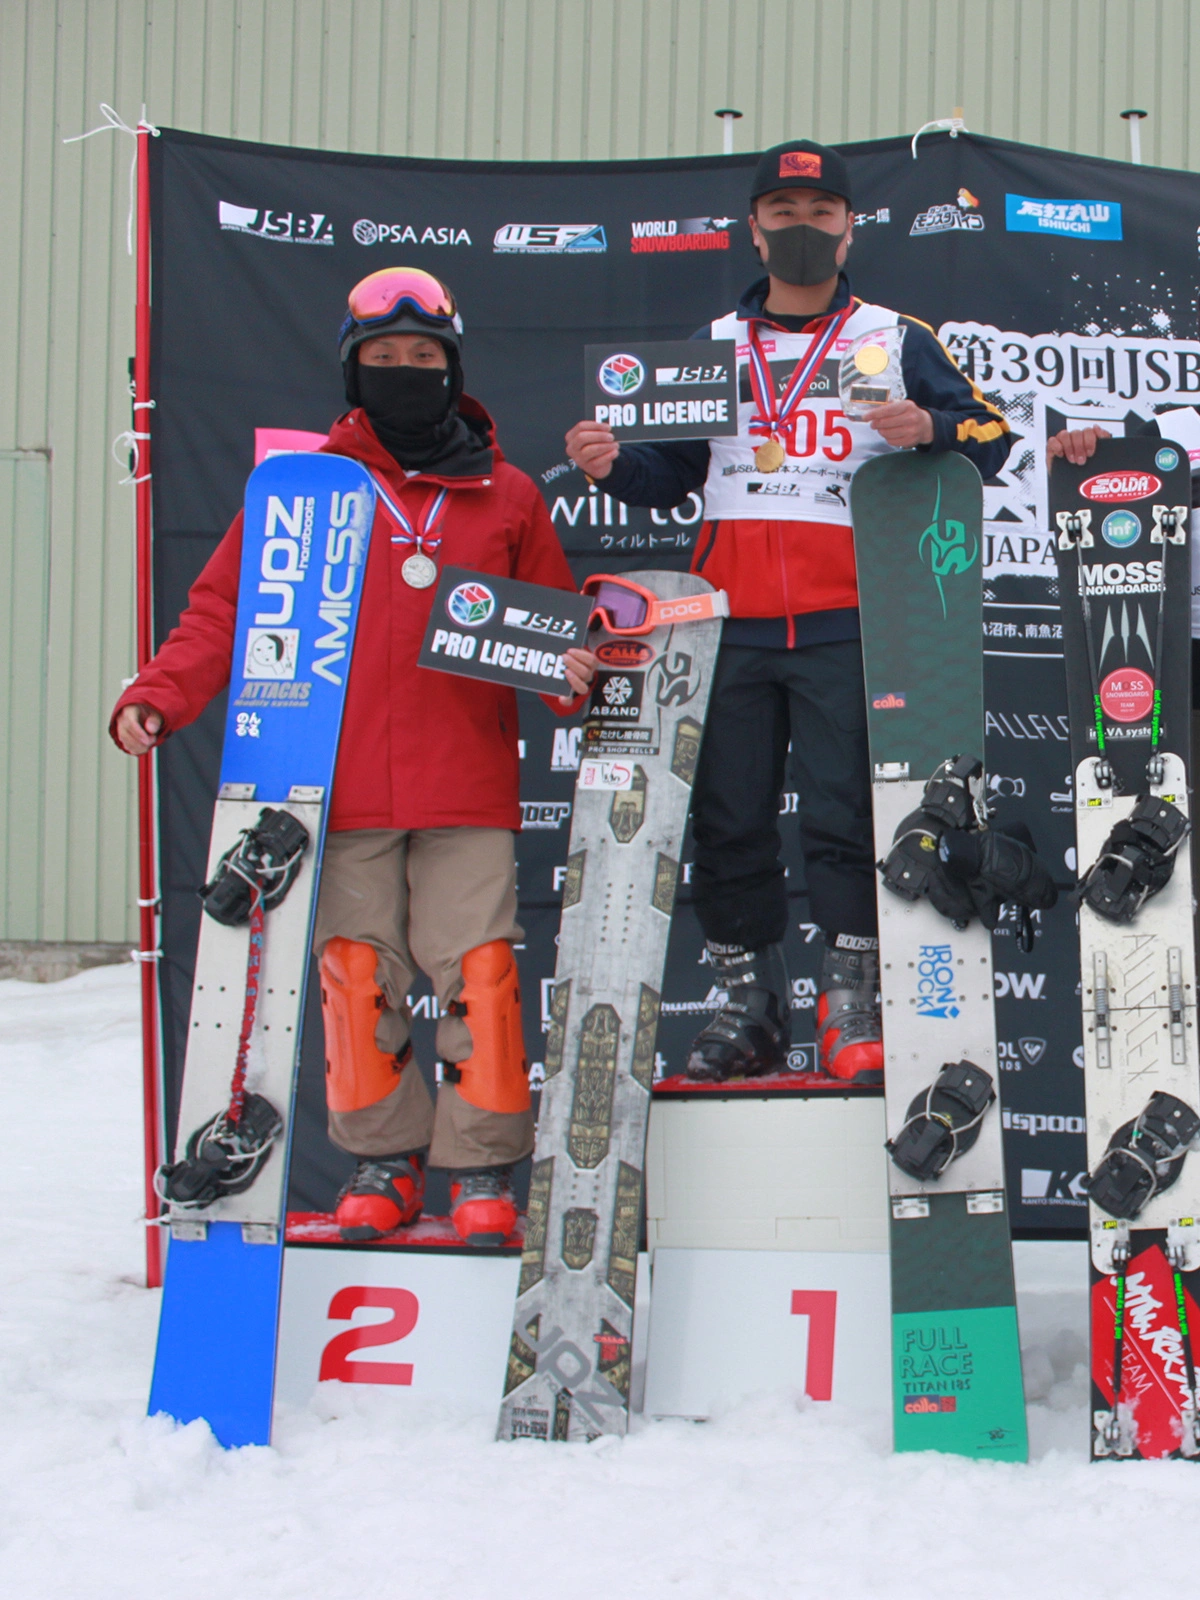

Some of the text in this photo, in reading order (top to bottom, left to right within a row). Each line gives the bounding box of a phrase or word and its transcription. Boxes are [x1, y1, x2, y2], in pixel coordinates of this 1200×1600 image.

[1016, 201, 1110, 222] 石打丸山
[246, 209, 335, 240] JSBA
[378, 224, 472, 246] PSA ASIA
[631, 221, 677, 238] WORLD
[1038, 217, 1091, 233] ISHIUCHI
[631, 231, 731, 254] SNOWBOARDING
[673, 364, 728, 383] JSBA
[595, 399, 729, 429] PRO LICENCE
[751, 408, 853, 462] 05
[757, 482, 800, 496] JSBA
[298, 496, 316, 570] hardboots
[600, 533, 691, 550] ウィルトール
[254, 495, 305, 626] UPZ
[1078, 561, 1165, 586] MOSS
[1078, 583, 1167, 596] SNOWBOARDS
[522, 611, 578, 638] JSBA
[431, 628, 477, 661] PRO
[479, 638, 567, 681] LICENCE
[239, 681, 312, 700] ATTACKS
[1111, 681, 1144, 691] MOSS
[590, 705, 640, 718] ABAND
[1089, 727, 1124, 738] in-VA
[520, 804, 570, 823] ber
[1002, 1107, 1086, 1136] ispoo
[318, 1285, 420, 1386] 2
[790, 1288, 838, 1402] 1
[904, 1326, 968, 1353] FULL
[900, 1351, 975, 1380] RACE
[904, 1380, 948, 1394] TITAN
